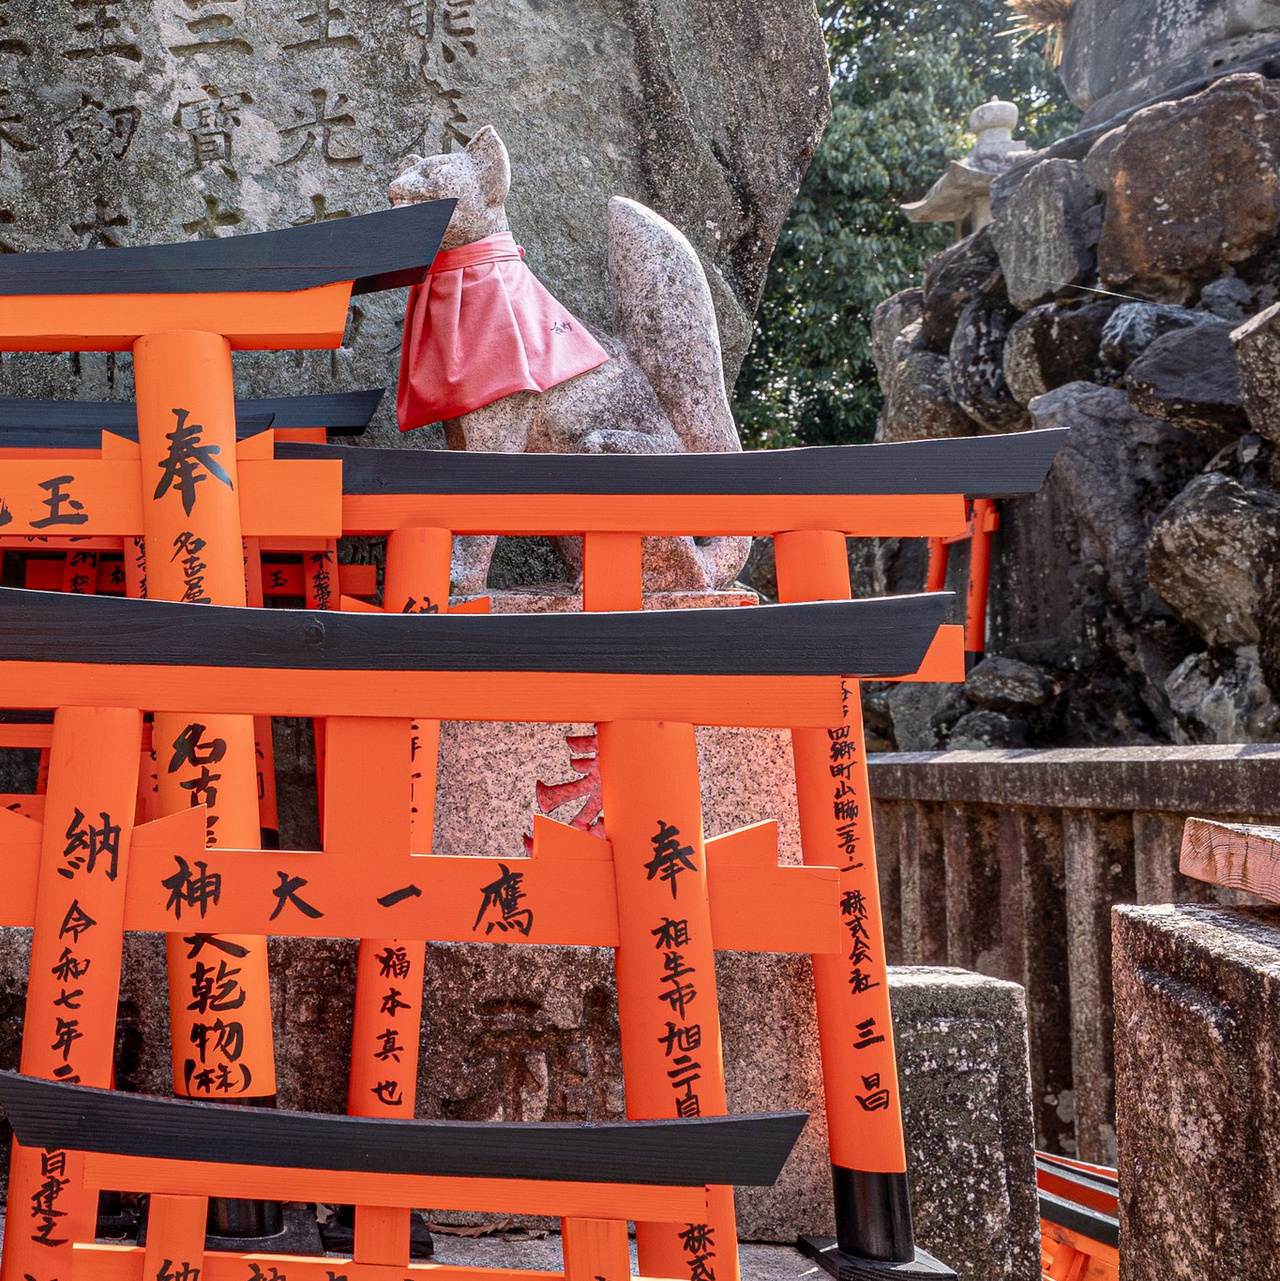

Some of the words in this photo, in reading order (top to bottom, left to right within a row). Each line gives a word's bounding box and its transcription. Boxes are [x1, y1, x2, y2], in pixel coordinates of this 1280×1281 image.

[153, 407, 233, 517] 奉
[170, 531, 212, 605] 名古屋
[57, 807, 122, 882] 納
[644, 820, 698, 899] 奉
[840, 890, 880, 995] 株式会社
[371, 947, 412, 1106] 福本真也
[853, 1017, 890, 1112] 三昌
